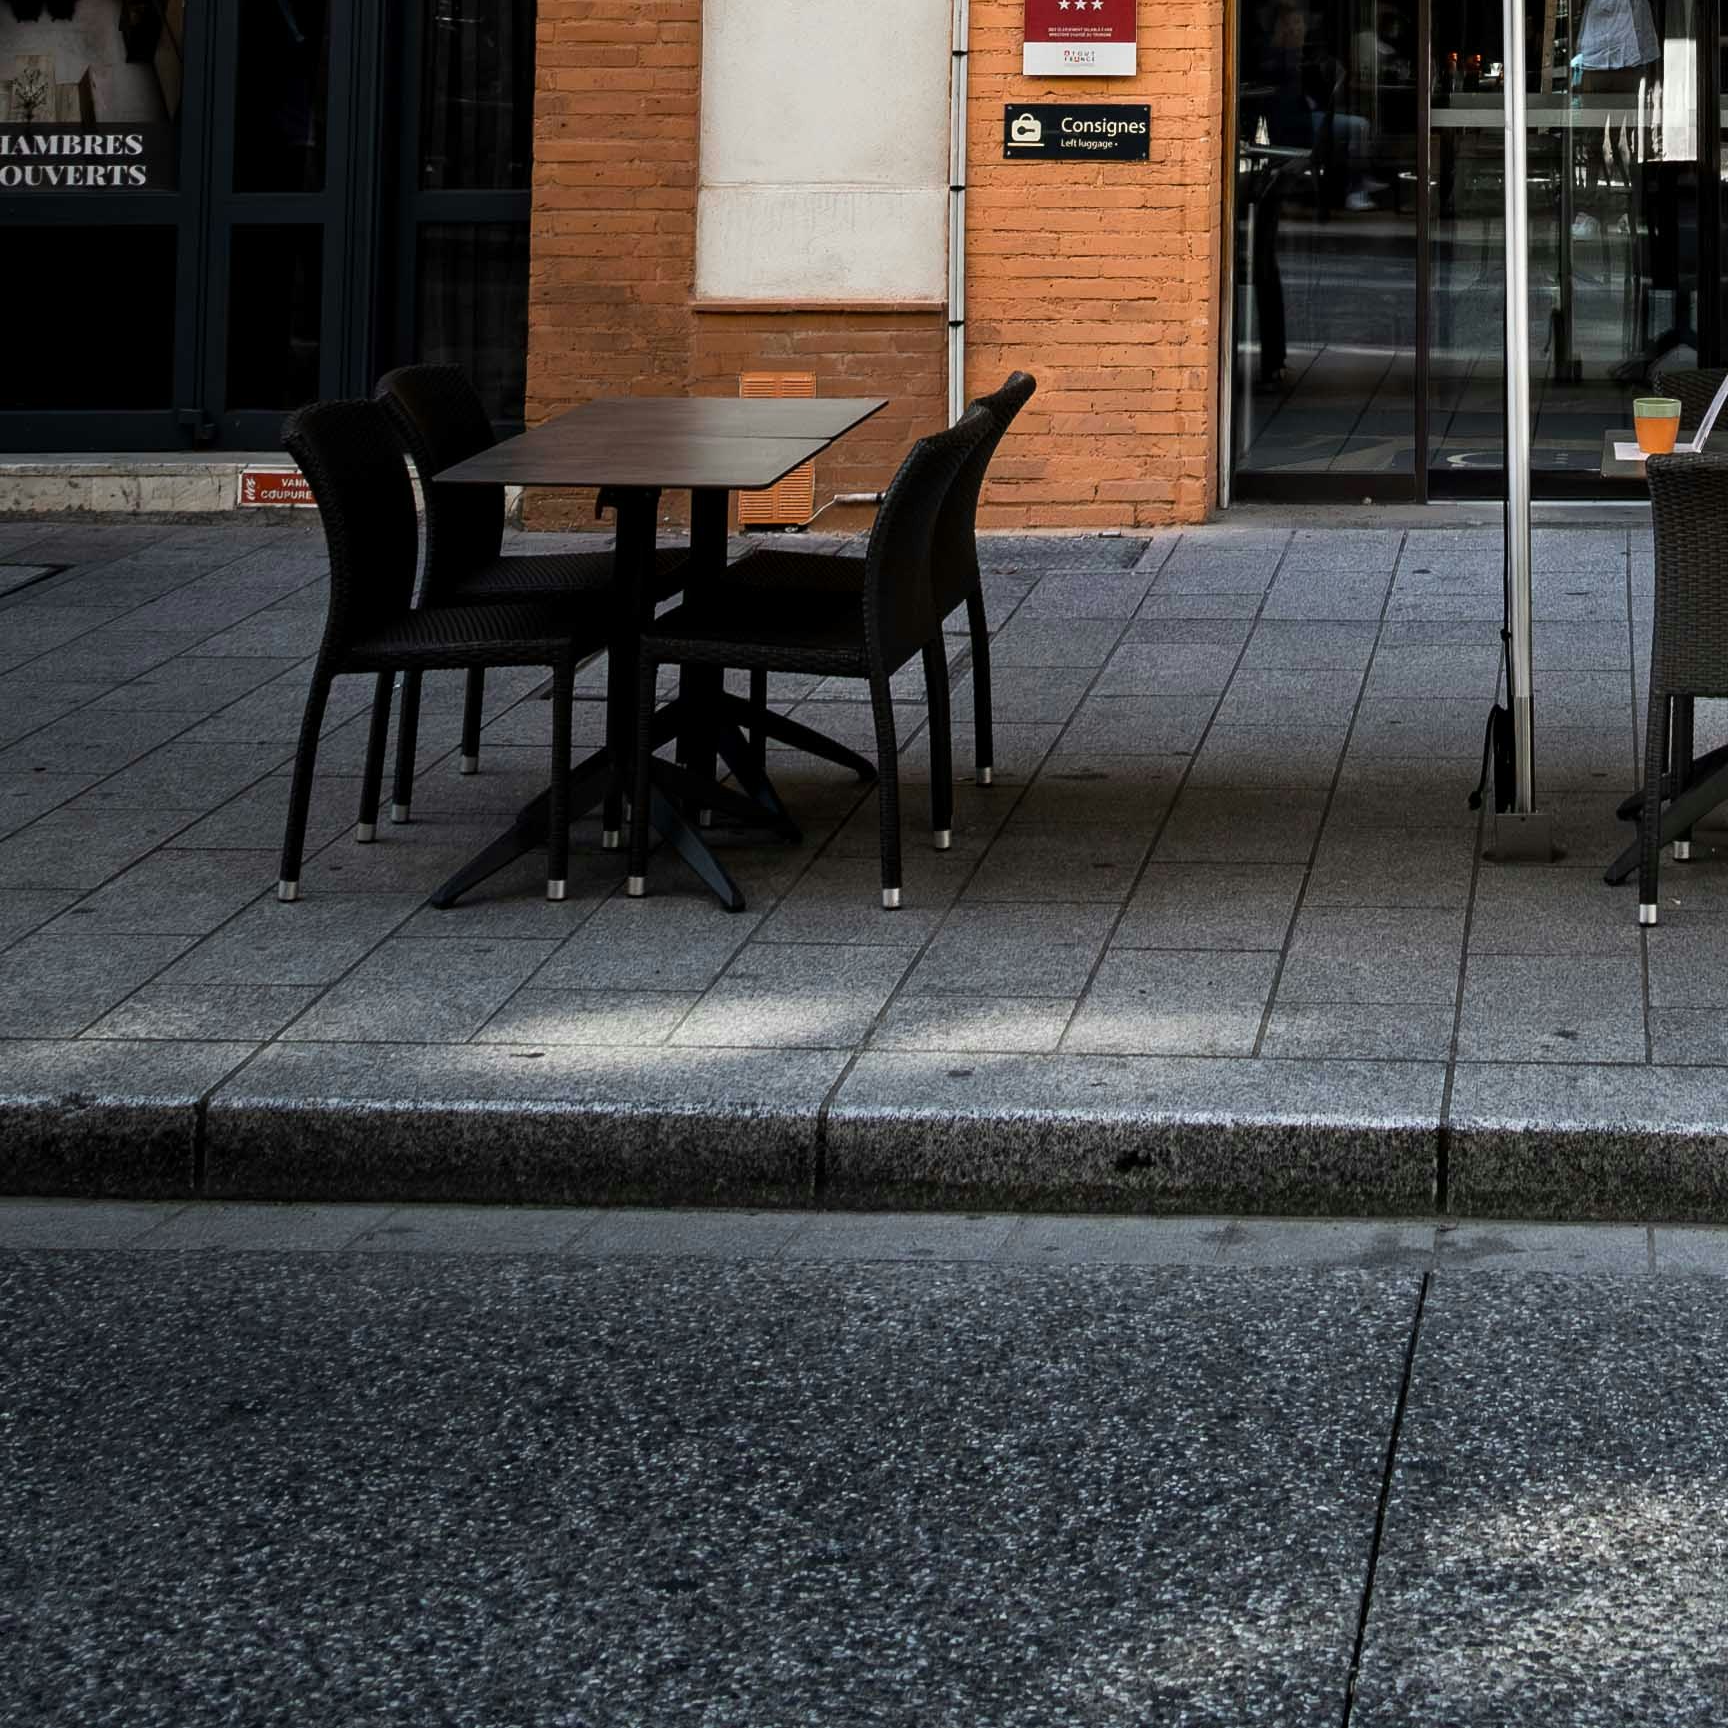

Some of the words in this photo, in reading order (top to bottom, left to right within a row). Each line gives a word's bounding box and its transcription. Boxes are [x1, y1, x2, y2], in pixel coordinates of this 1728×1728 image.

[1061, 117, 1147, 137] Consignes
[1060, 138, 1077, 148] Left
[1078, 138, 1113, 150] luggage
[281, 478, 310, 488] VANN
[260, 489, 313, 500] COUPURE
